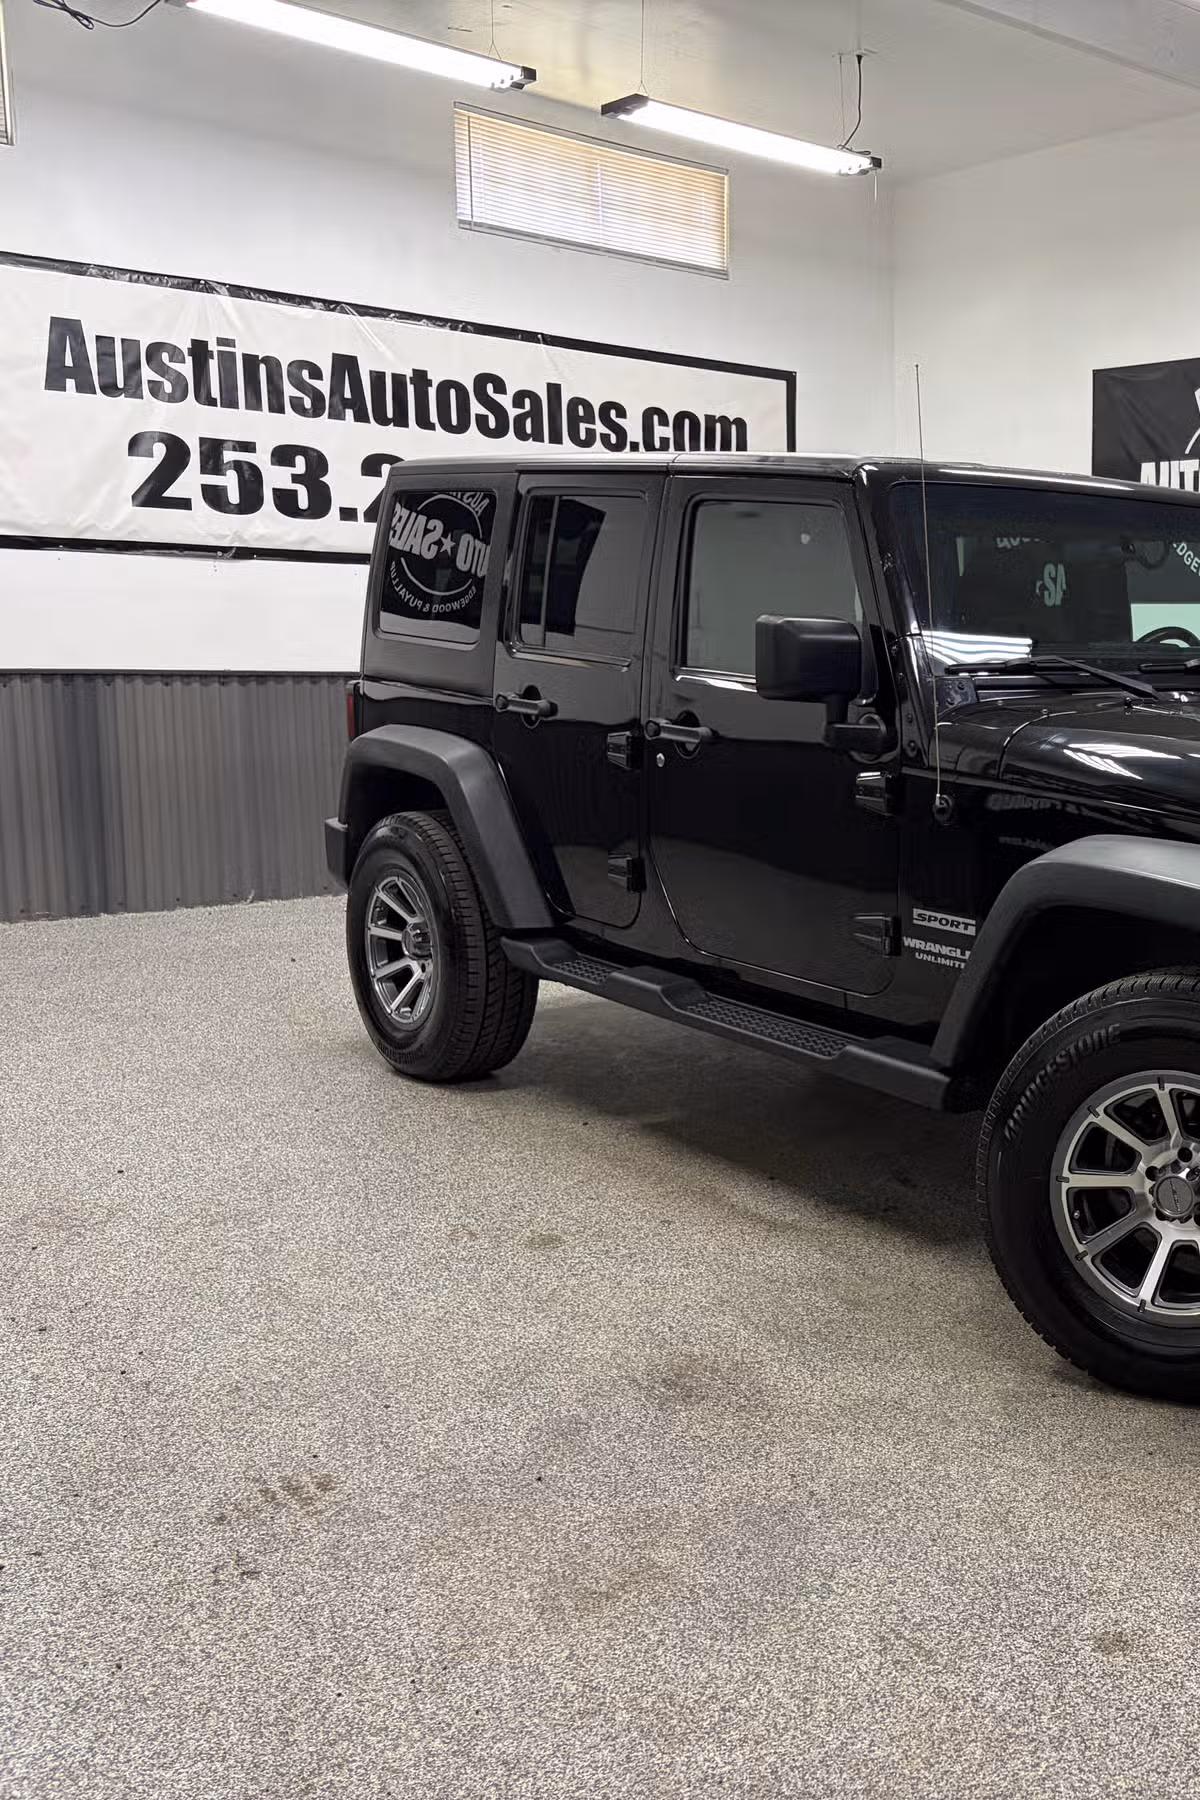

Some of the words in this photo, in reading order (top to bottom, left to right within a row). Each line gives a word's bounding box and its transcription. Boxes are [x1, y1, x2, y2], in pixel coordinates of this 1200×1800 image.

[44, 316, 749, 453] AustinsAutoSales.com
[127, 431, 406, 523] 253.2
[915, 911, 976, 932] SPORT
